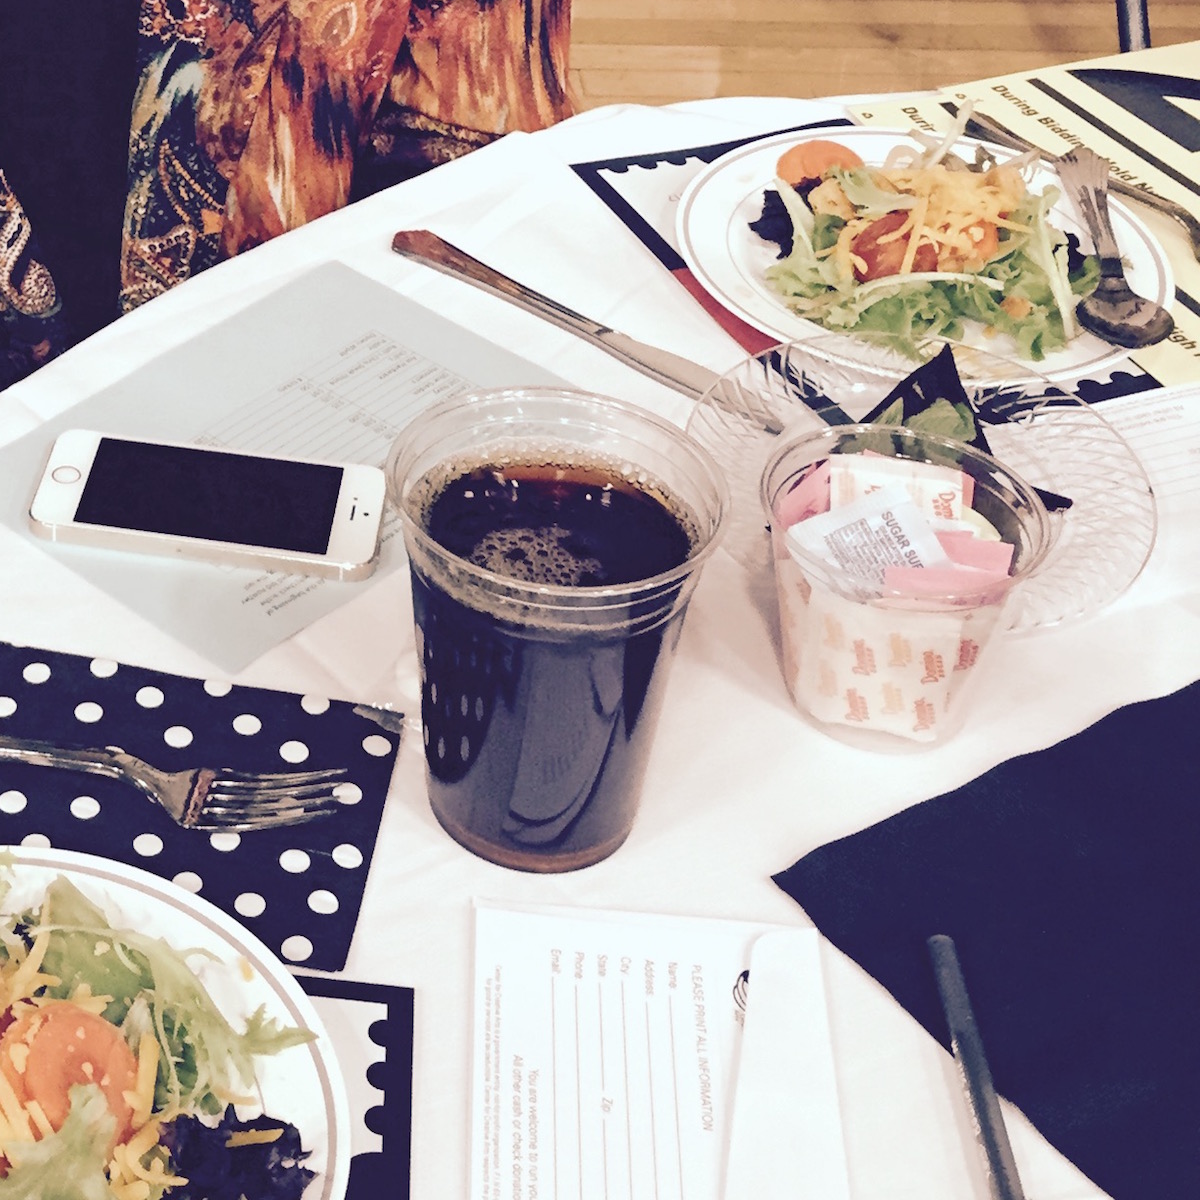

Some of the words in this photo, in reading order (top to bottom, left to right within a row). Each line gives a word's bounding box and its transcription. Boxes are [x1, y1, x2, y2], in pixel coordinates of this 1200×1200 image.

[901, 106, 937, 133] Duri
[992, 84, 1039, 116] During
[1037, 114, 1090, 149] Biddin
[1169, 326, 1197, 351] igh
[881, 511, 912, 549] SUGAR
[574, 952, 585, 979] Phone
[597, 954, 609, 977] State
[620, 957, 632, 975] City
[644, 960, 656, 995] Address
[668, 962, 679, 988] Name
[692, 965, 705, 1001] PLEASE
[694, 1004, 707, 1033] PRINT
[696, 1035, 708, 1054] ALL
[512, 1054, 523, 1066] All
[512, 1068, 522, 1092] other
[528, 1069, 540, 1085] You
[512, 1095, 523, 1117] cash
[529, 1088, 537, 1103] are
[600, 1097, 614, 1113] Zip
[698, 1056, 714, 1133] INFORMATION
[512, 1120, 521, 1129] or
[528, 1106, 539, 1149] welcome
[512, 1132, 523, 1160] check
[528, 1153, 538, 1162] to
[529, 1165, 538, 1181] run
